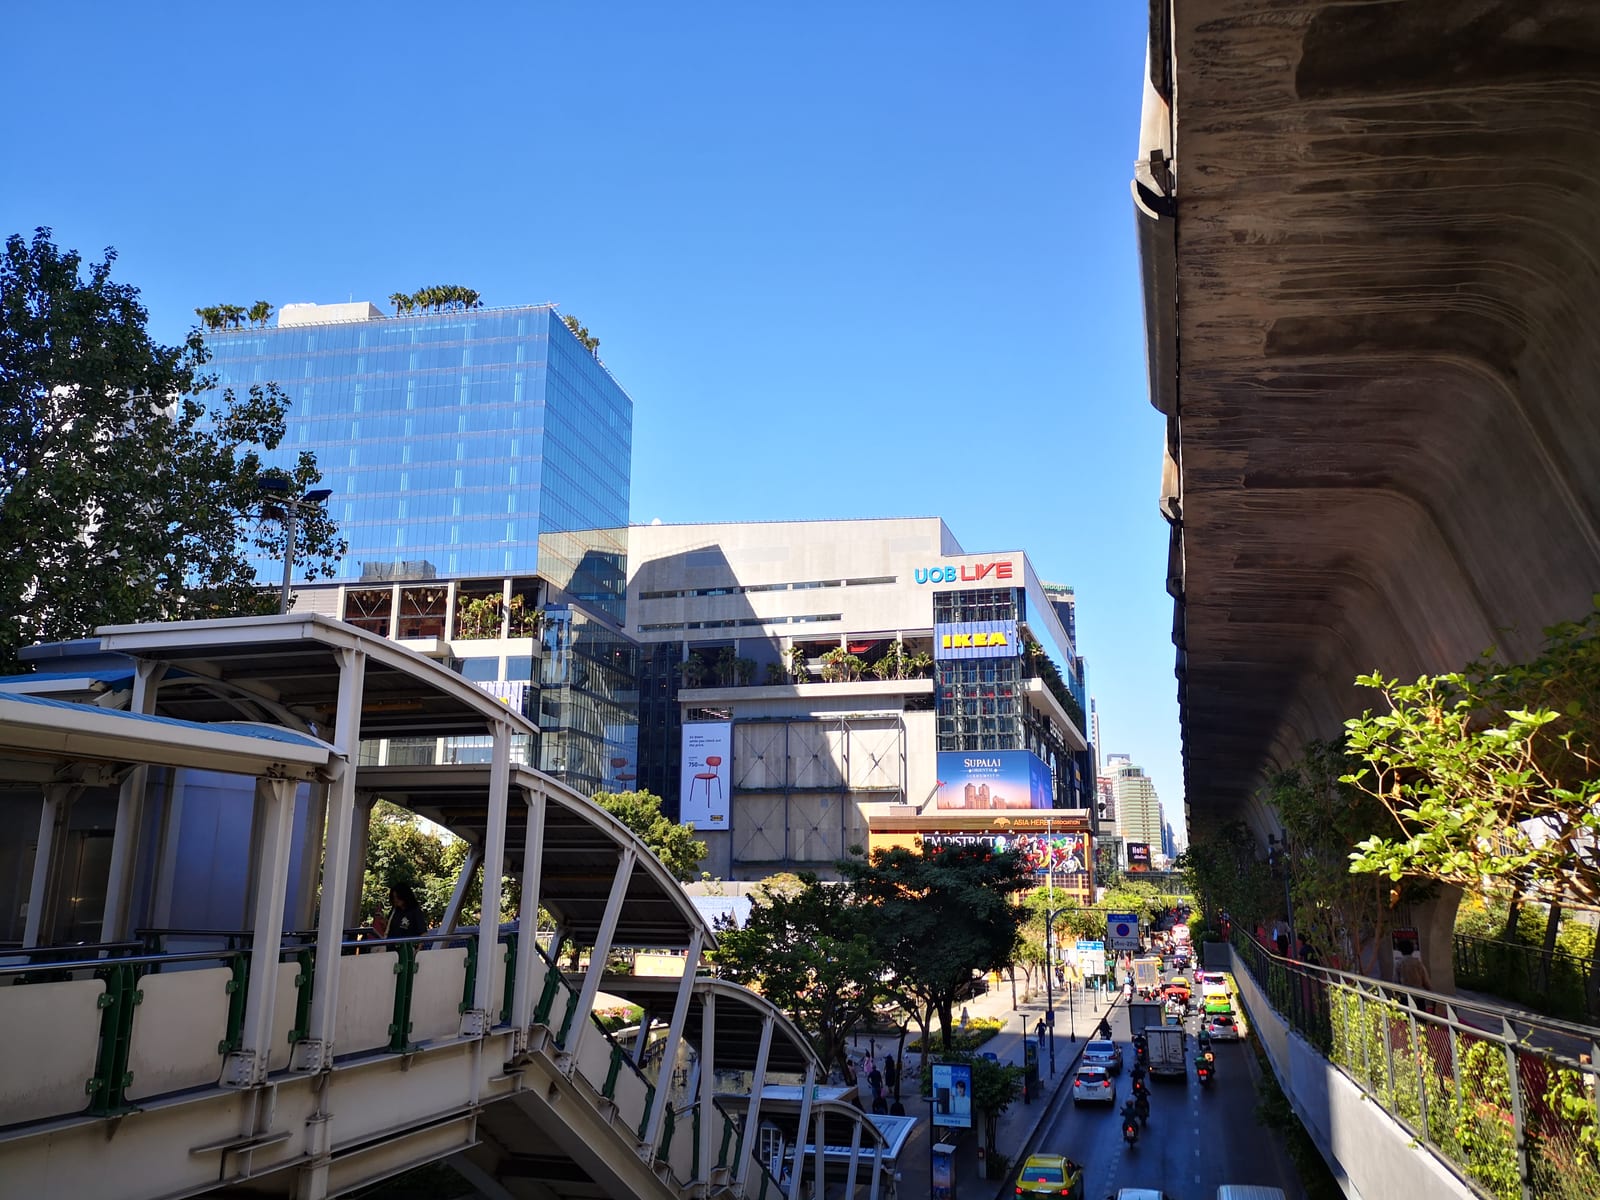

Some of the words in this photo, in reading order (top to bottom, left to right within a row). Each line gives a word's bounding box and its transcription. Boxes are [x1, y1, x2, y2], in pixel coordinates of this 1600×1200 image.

[914, 566, 956, 584] UOB
[960, 561, 1013, 582] LIVE
[942, 631, 1008, 649] IKEA
[964, 758, 1001, 768] SUPALAI
[944, 836, 996, 847] DISTRICT
